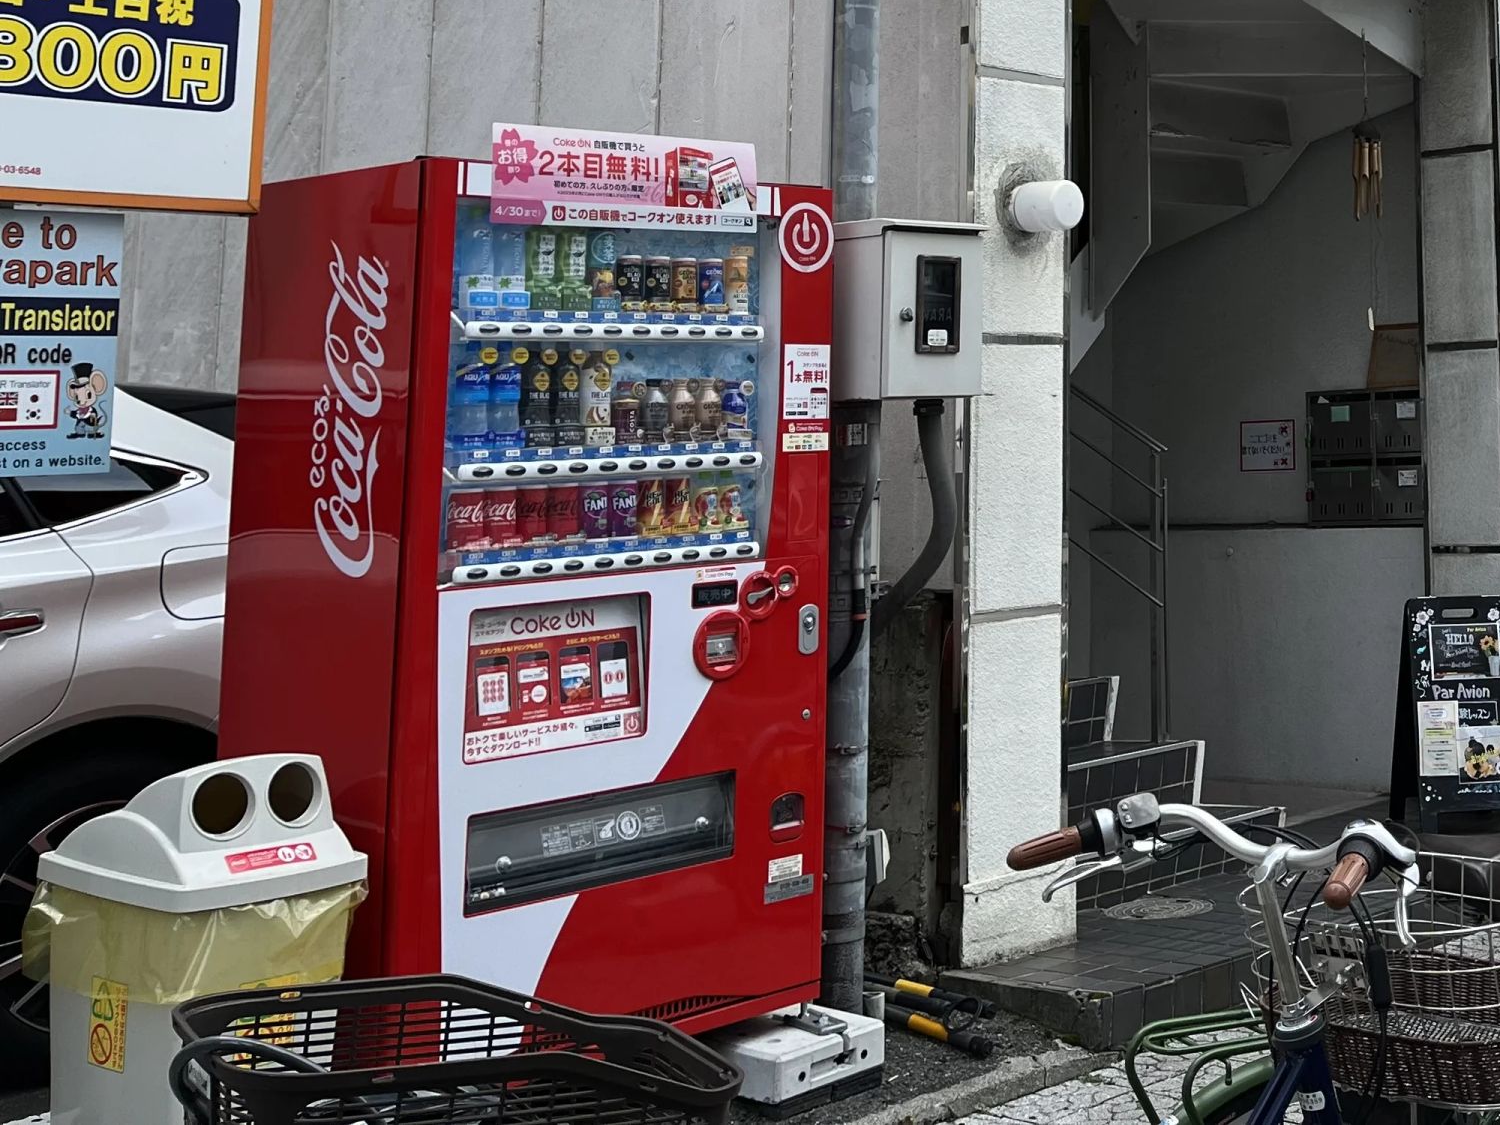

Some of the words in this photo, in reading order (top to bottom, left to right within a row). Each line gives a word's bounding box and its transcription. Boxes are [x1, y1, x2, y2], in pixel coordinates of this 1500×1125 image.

[552, 137, 577, 148] Coke
[497, 147, 529, 165] お得
[537, 149, 660, 183] 2本目無料!
[40, 216, 78, 250] to
[0, 254, 119, 289] apark
[0, 302, 117, 332] Translator
[27, 343, 73, 364] code
[314, 239, 390, 579] Coca-Cola
[13, 458, 30, 468] on
[35, 457, 43, 467] a
[49, 453, 106, 467] website.
[510, 614, 562, 636] Coke
[1444, 633, 1475, 646] HELLO
[1431, 684, 1455, 700] Par
[1456, 682, 1491, 699] Avion
